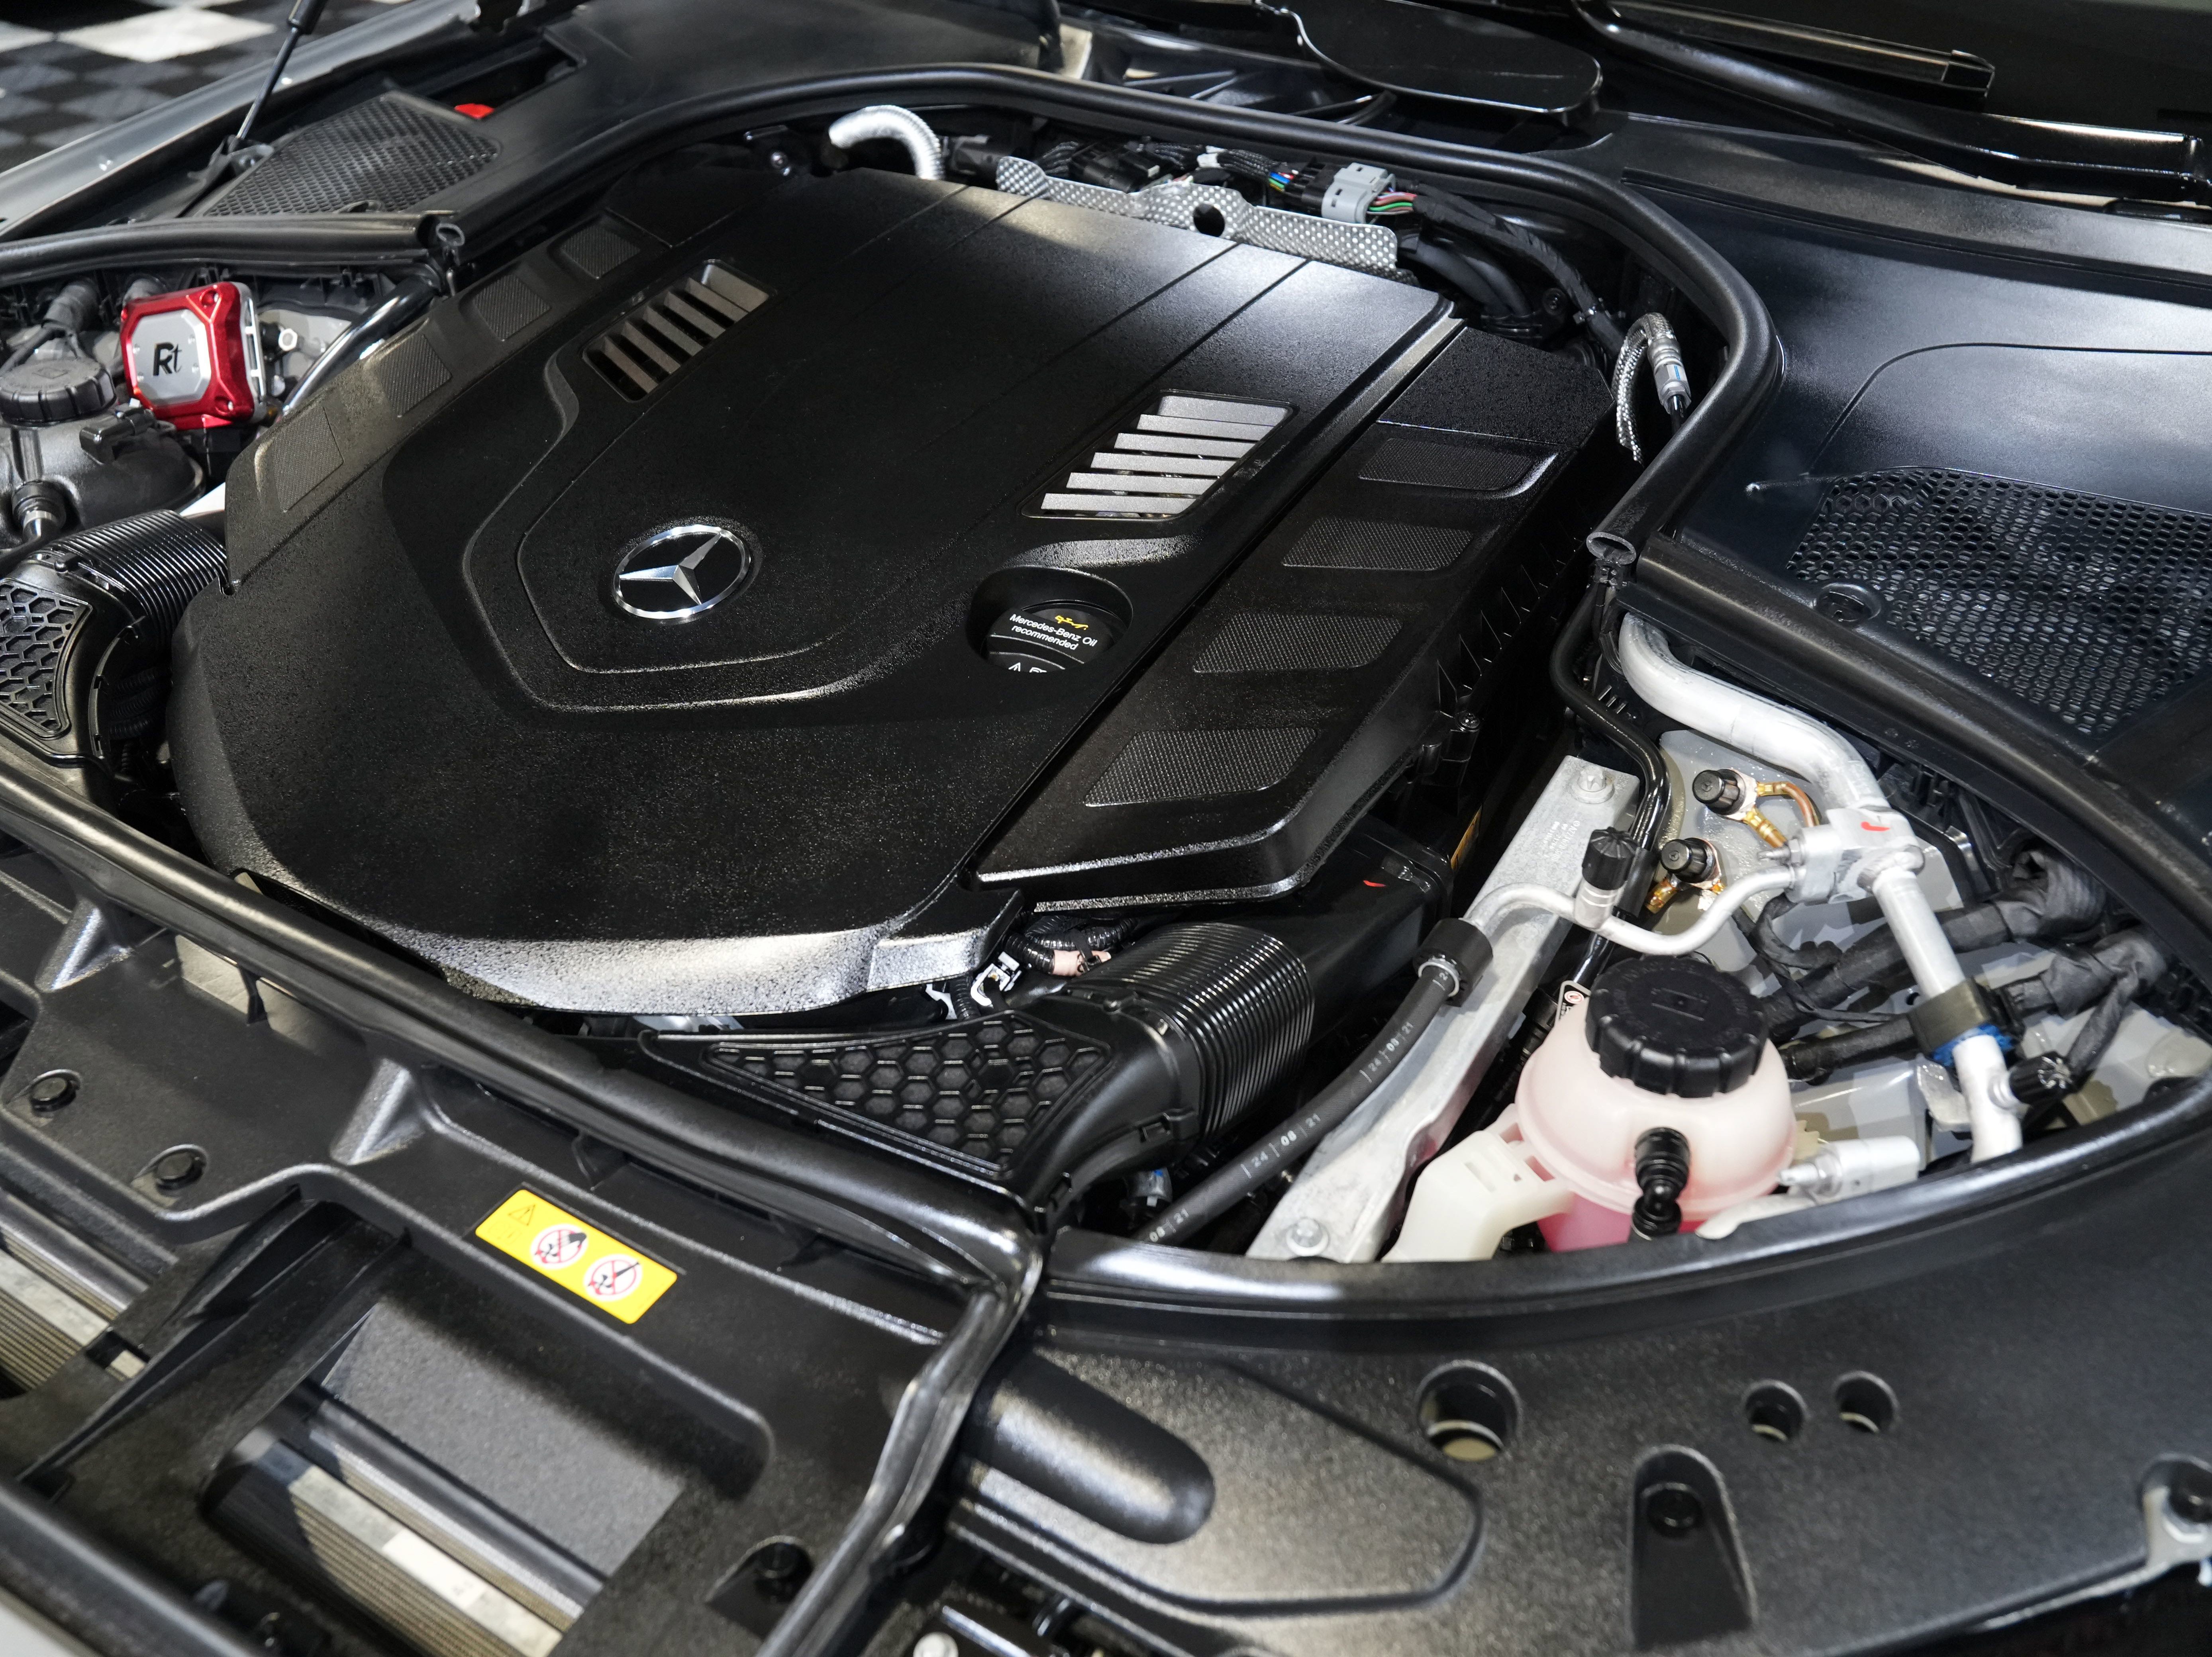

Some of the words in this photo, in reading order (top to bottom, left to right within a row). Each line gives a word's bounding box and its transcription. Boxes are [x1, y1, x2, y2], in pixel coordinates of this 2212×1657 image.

[1010, 614, 1081, 641] Mercedes-Benz
[1082, 637, 1098, 646] Oil
[1011, 625, 1079, 650] recommended
